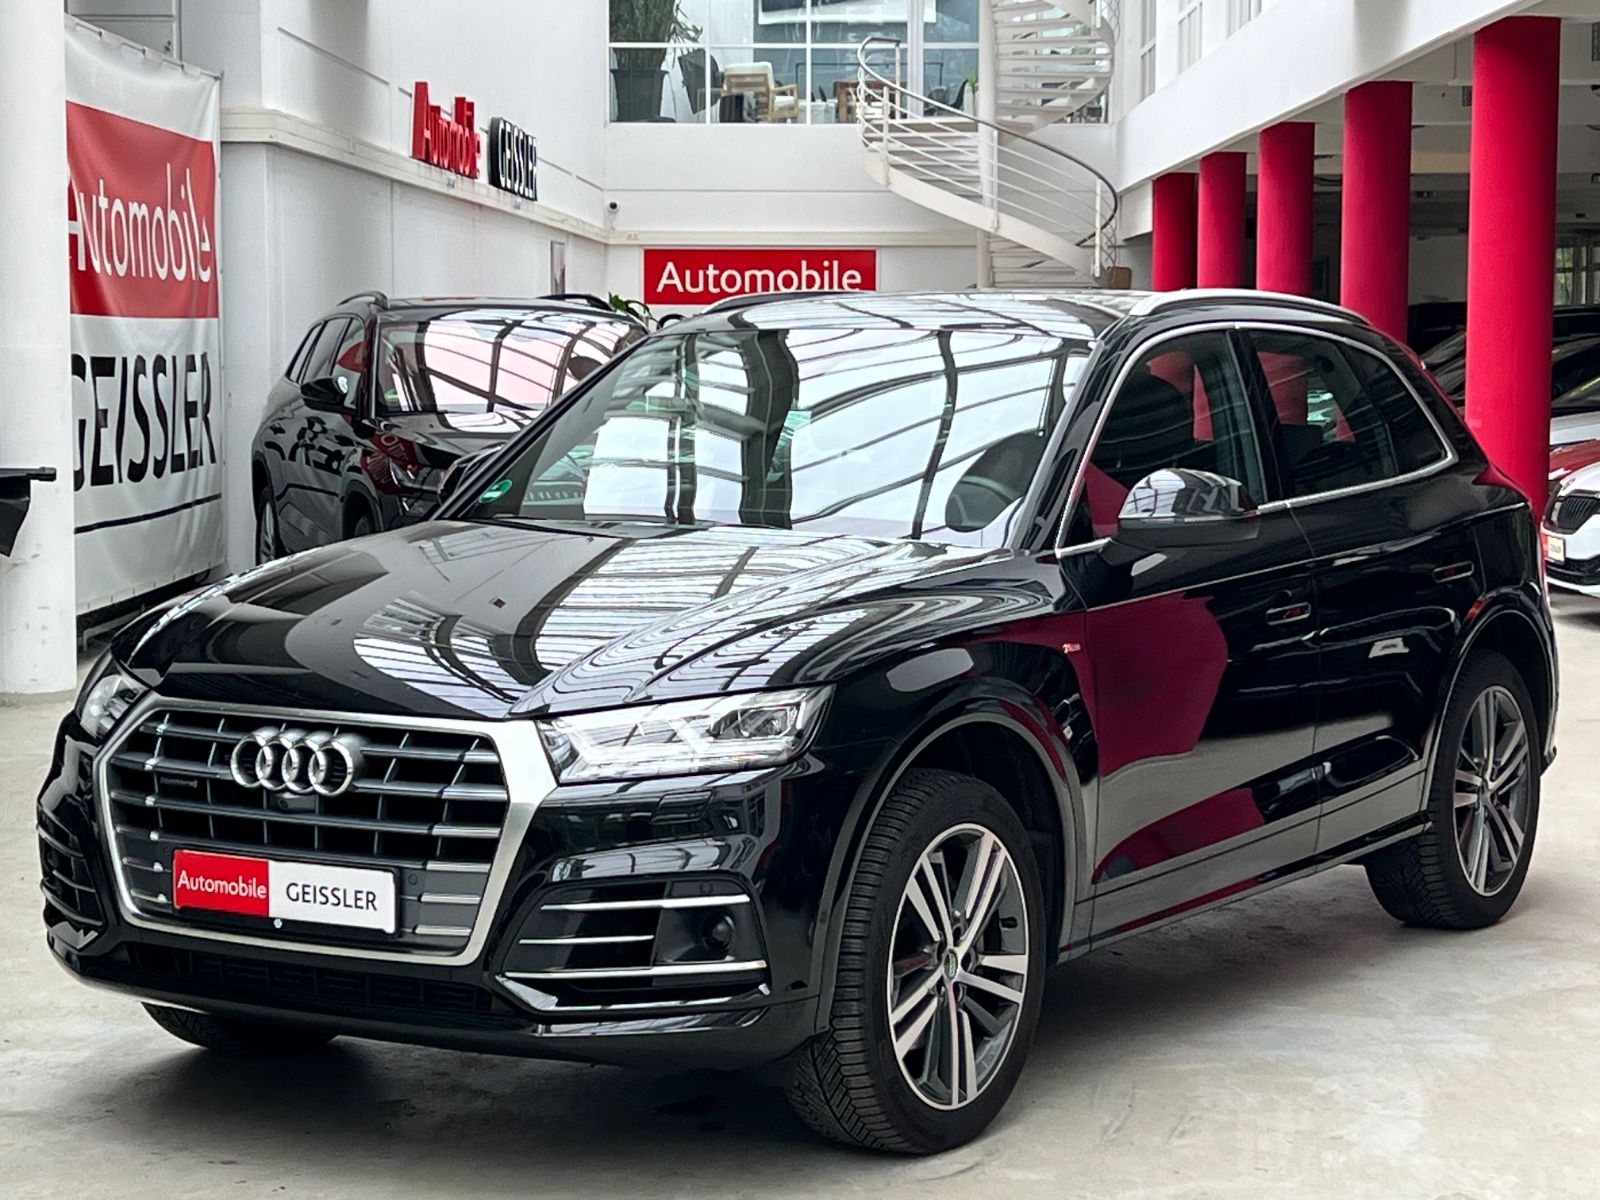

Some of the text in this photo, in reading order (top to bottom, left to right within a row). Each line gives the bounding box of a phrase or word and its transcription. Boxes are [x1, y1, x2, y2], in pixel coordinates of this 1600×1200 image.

[656, 260, 862, 293] Automobile
[177, 870, 378, 911] Automobile GEISSLER
